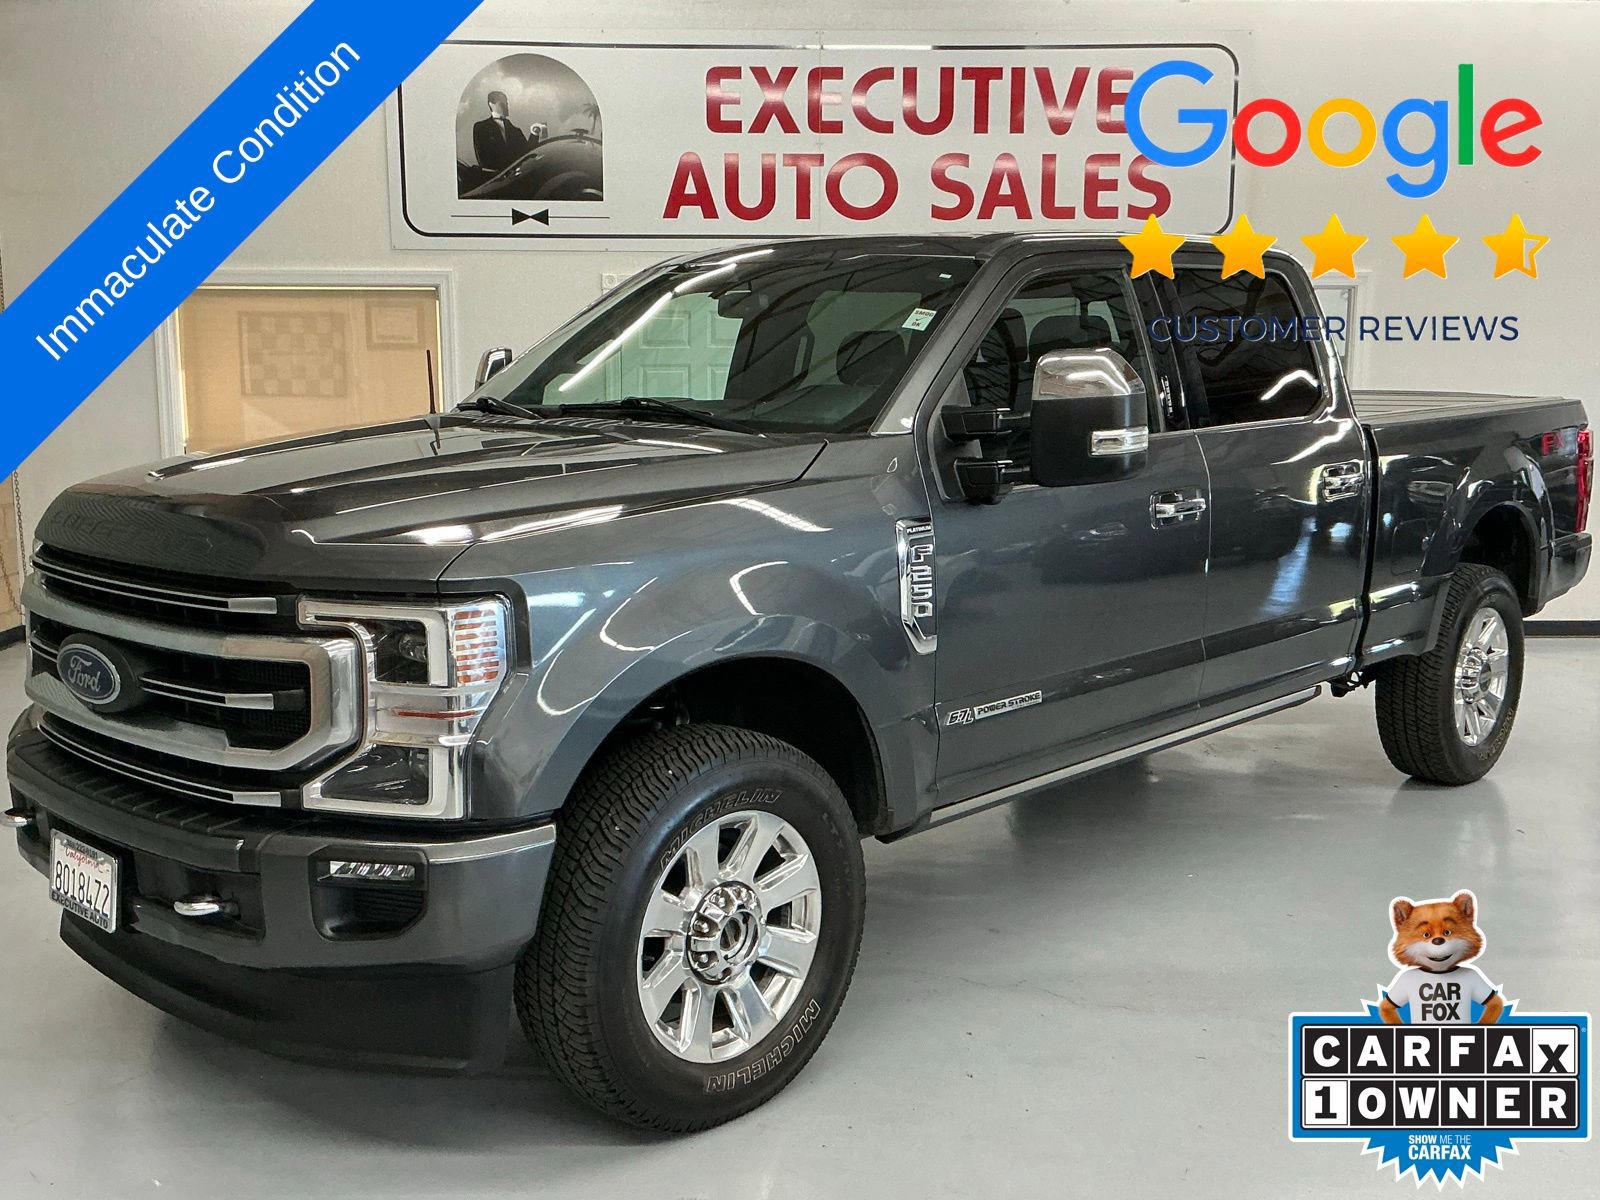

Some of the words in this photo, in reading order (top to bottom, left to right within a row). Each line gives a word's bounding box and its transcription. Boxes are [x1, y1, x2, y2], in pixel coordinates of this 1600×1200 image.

[705, 66, 1134, 136] EXECUTIVE
[662, 152, 899, 220] AUTO
[930, 152, 1172, 220] SALES
[914, 310, 935, 318] SMOG
[68, 655, 101, 692] Ford
[977, 701, 1007, 715] POWER
[1008, 692, 1041, 707] STROKE
[660, 788, 783, 871] MICHELIN
[51, 892, 89, 918] EXECUTIVE
[706, 998, 821, 1093] MICHELIN
